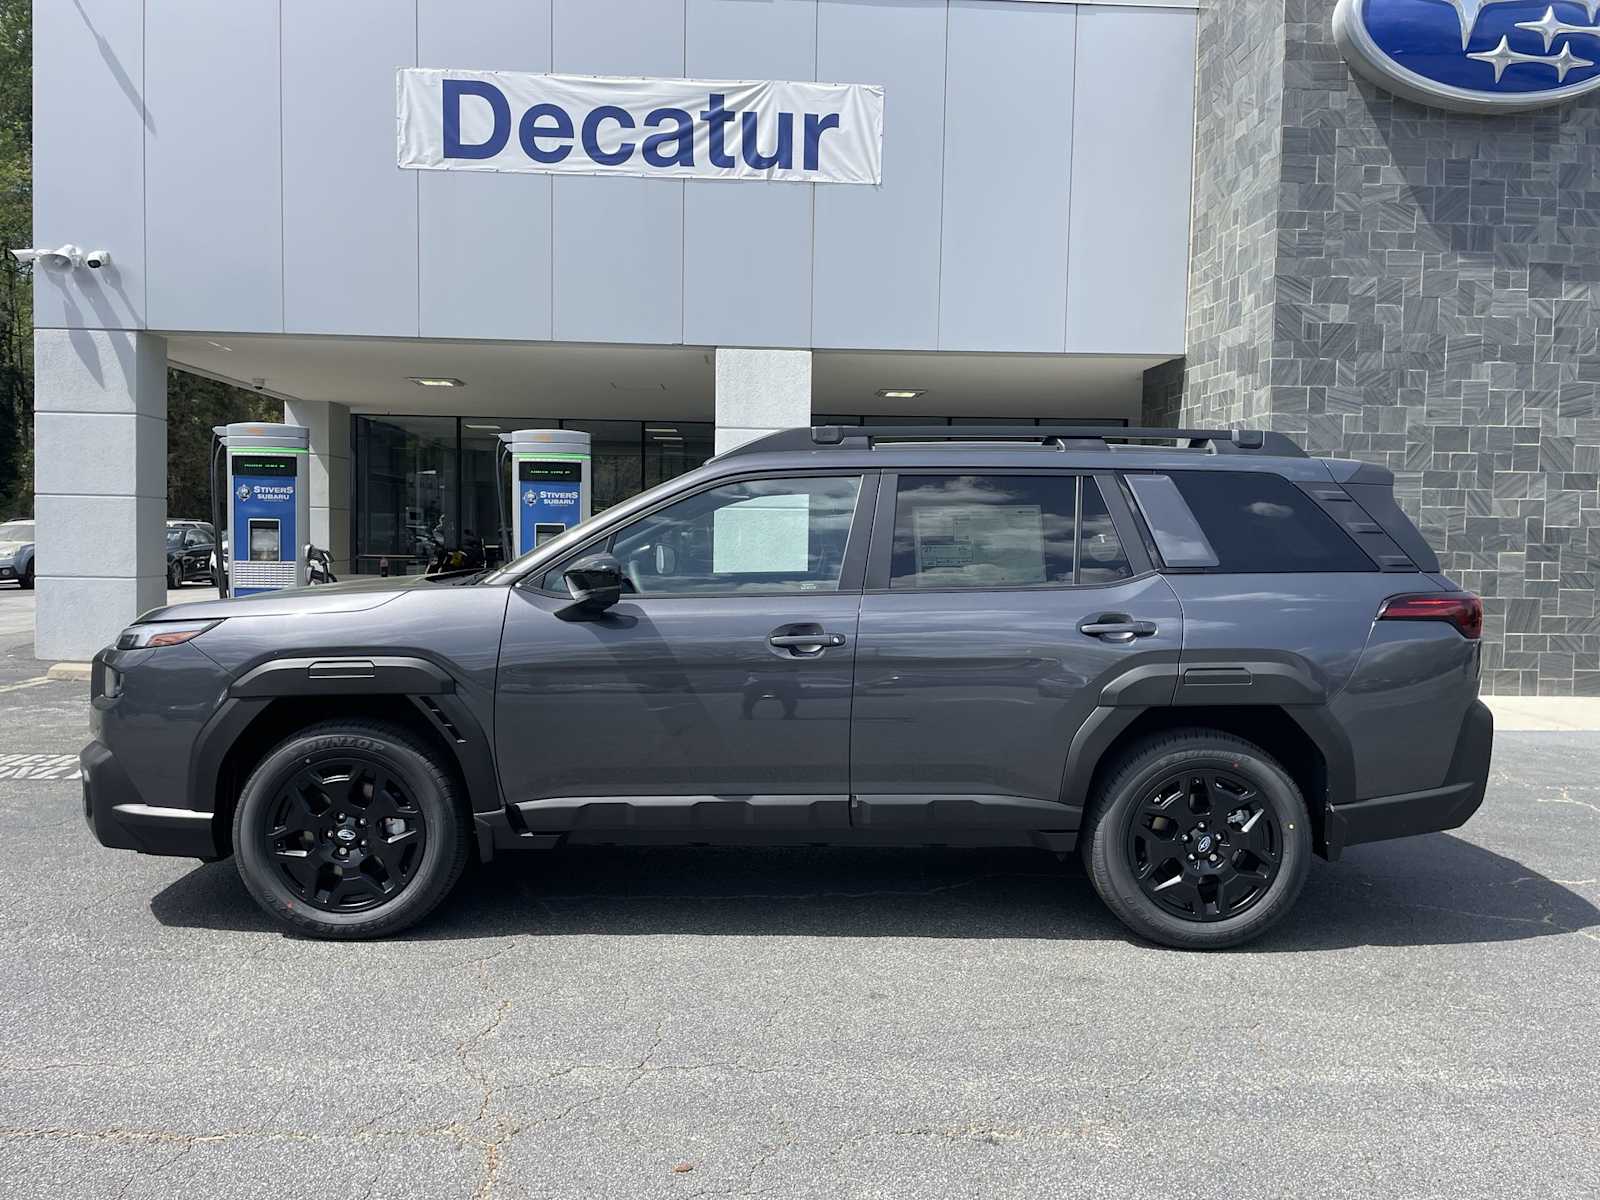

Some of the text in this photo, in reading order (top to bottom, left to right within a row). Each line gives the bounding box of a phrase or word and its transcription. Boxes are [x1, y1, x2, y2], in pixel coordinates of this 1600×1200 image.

[441, 79, 839, 171] Decatur
[253, 486, 294, 494] STIVERS
[540, 491, 578, 499] STIVERS
[303, 735, 385, 753] DUNLOP
